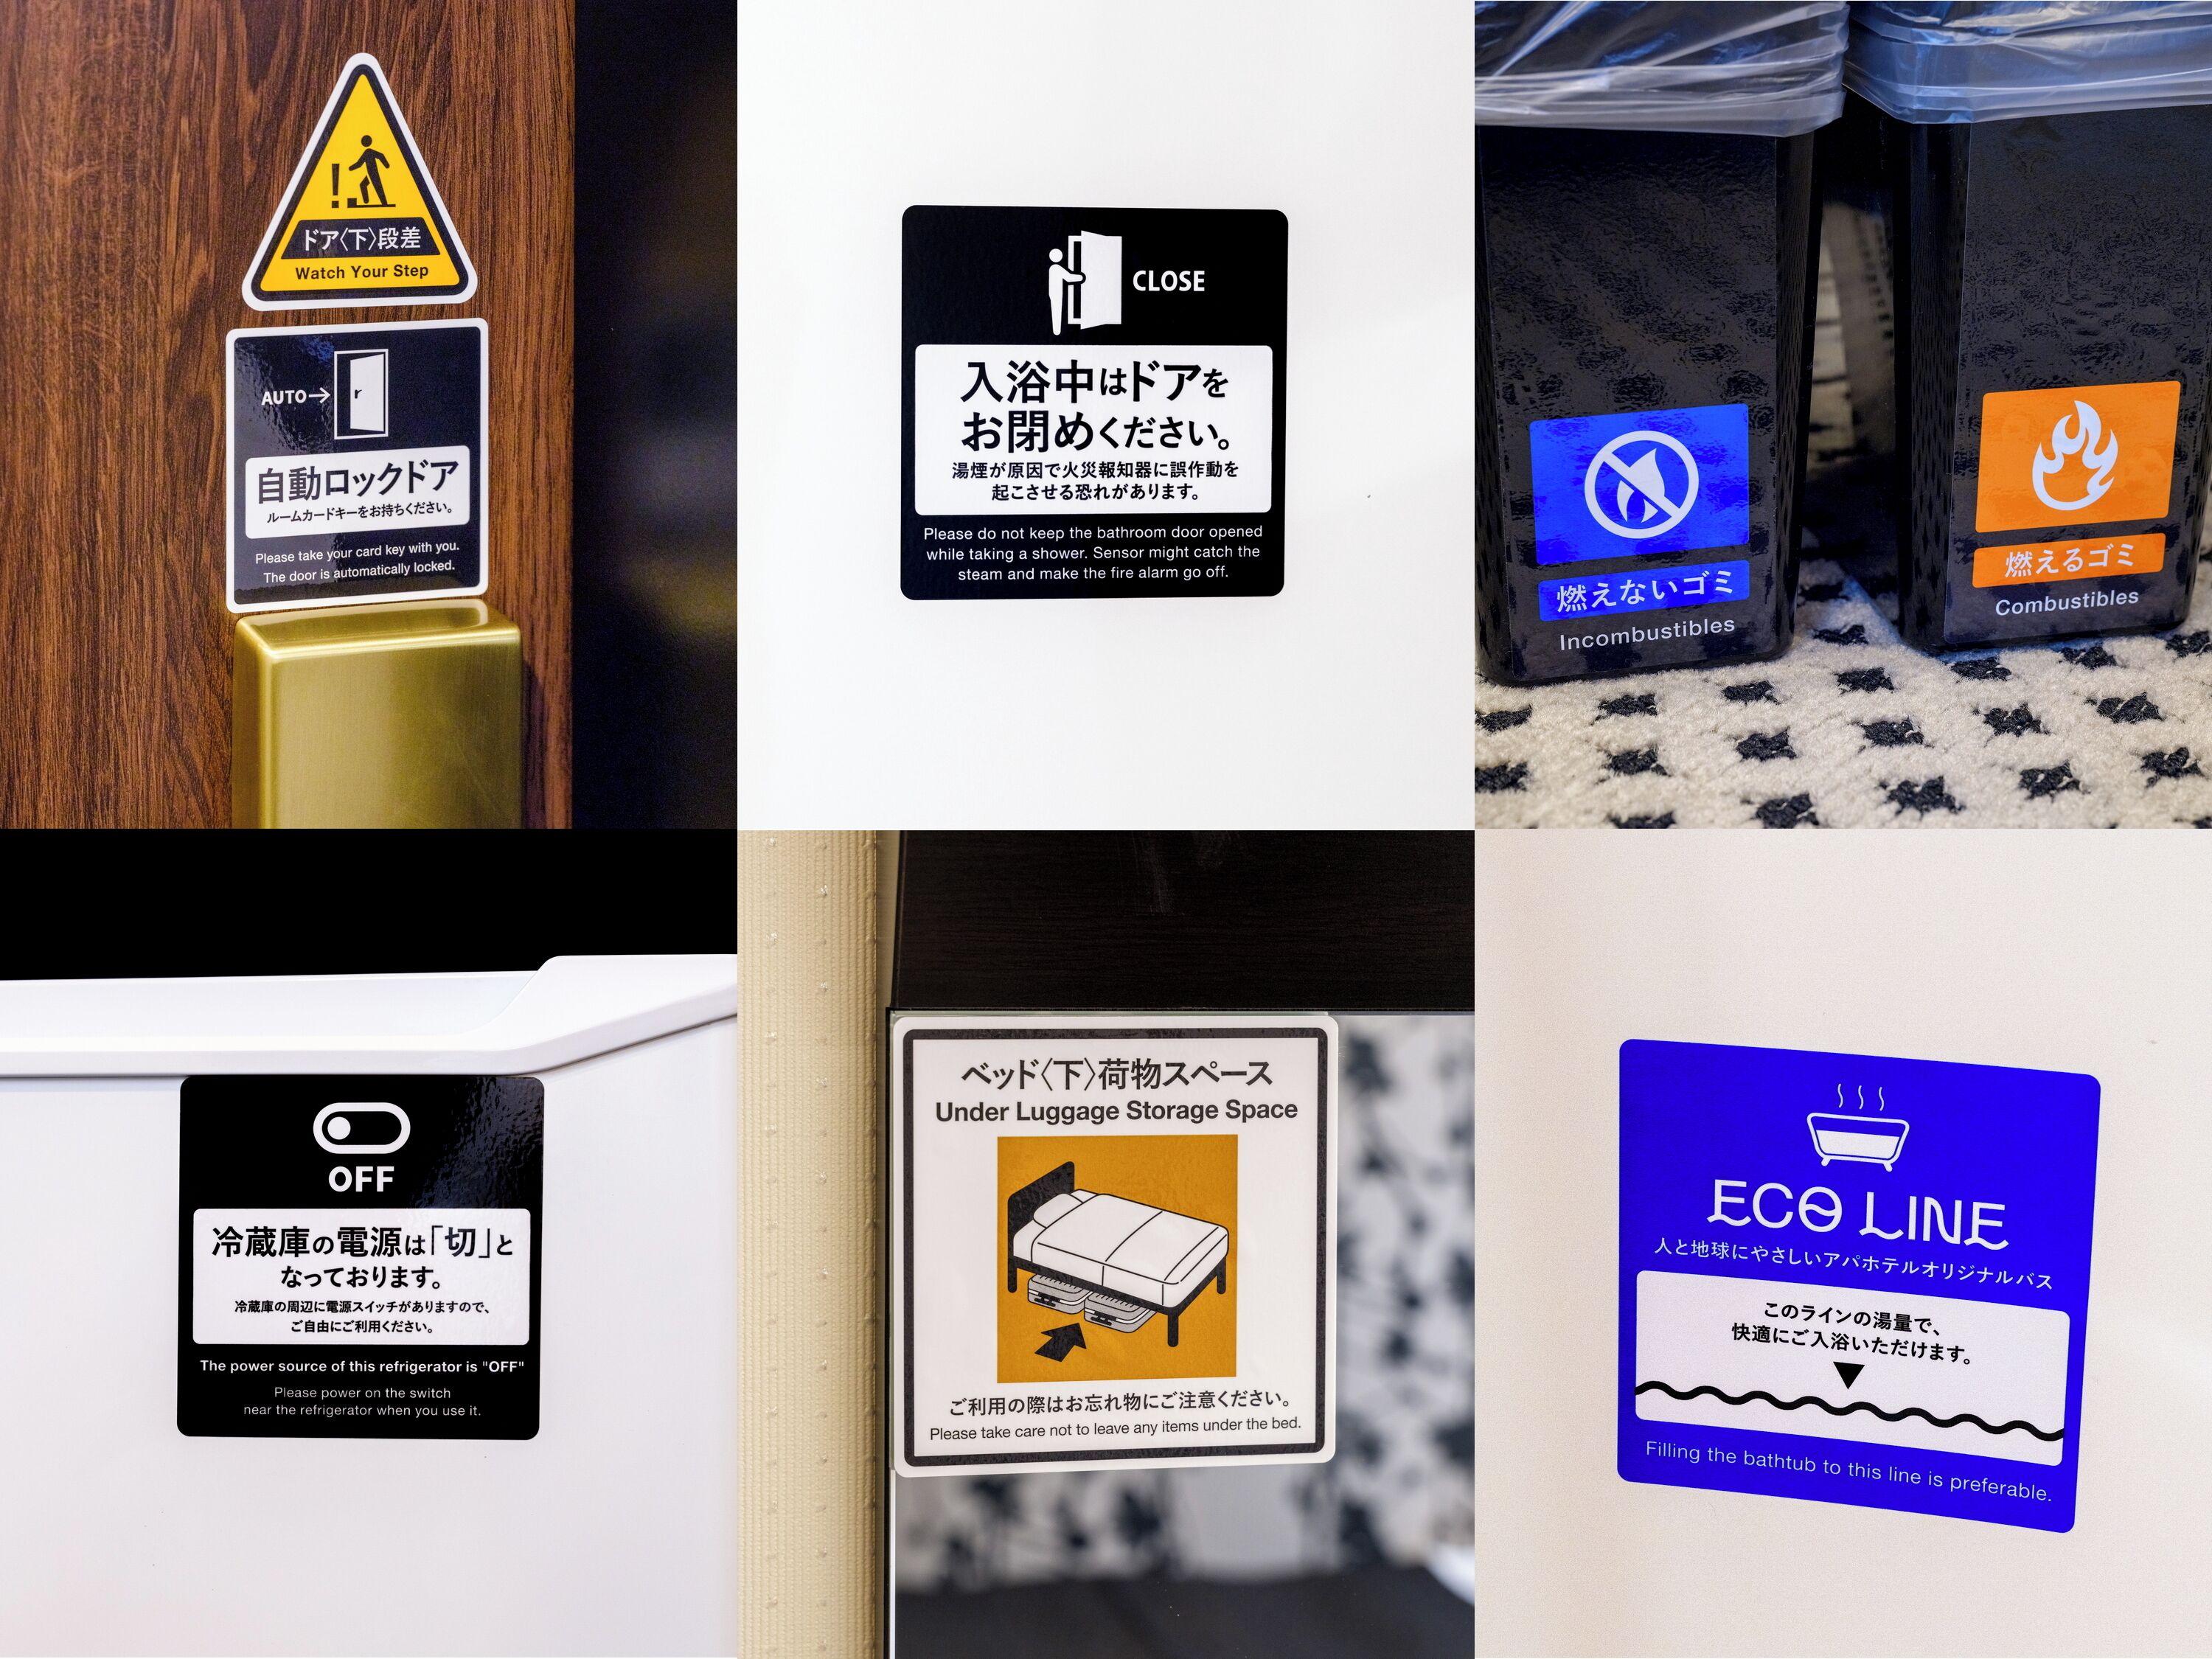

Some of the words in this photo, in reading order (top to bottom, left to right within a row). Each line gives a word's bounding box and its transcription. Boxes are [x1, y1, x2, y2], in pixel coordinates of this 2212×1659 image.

[296, 266, 344, 279] Watch
[351, 265, 388, 278] Your
[394, 265, 428, 279] Step
[1133, 271, 1204, 291] CLOSE
[961, 360, 1228, 403] 入浴中はドアを
[261, 390, 306, 406] AUTO
[961, 411, 1229, 453] お閉めください。
[953, 461, 1238, 479] 湯煙が原因で火災報知器に誤作動を
[259, 459, 459, 505] 自動ロックドア
[992, 484, 1197, 501] 起こさせる恐れがあります。
[268, 501, 451, 523] ルームカードキーをお持ちください。
[925, 528, 973, 540] Please
[978, 528, 995, 539] do
[1002, 528, 1024, 539] not
[1030, 527, 1064, 541] keep
[1070, 527, 1092, 538] the
[1098, 526, 1166, 538] bathroom
[1172, 526, 1204, 538] door
[1209, 526, 1262, 540] opened
[256, 553, 294, 564] Please
[298, 550, 323, 560] take
[327, 550, 352, 562] your
[356, 545, 381, 557] card
[386, 545, 405, 557] key
[408, 542, 432, 553] with
[436, 543, 459, 554] you.
[927, 549, 964, 560] while
[969, 548, 1013, 563] taking
[1019, 551, 1027, 559] a
[1032, 547, 1087, 559] shower.
[1093, 546, 1144, 558] Sensor
[1150, 546, 1189, 560] might
[1194, 546, 1232, 557] catch
[1238, 546, 1259, 557] the
[2005, 543, 2135, 578] 燃えるゴミ
[263, 573, 285, 583] The
[290, 571, 316, 581] door
[321, 569, 330, 579] is
[333, 563, 410, 578] automatically
[414, 560, 454, 572] locked.
[959, 569, 1002, 580] steam
[1008, 568, 1034, 580] and
[1040, 568, 1078, 579] make
[1084, 567, 1105, 578] the
[1111, 567, 1133, 578] fire
[1139, 567, 1178, 578] alarm
[1183, 568, 1200, 580] go
[1206, 566, 1228, 577] off.
[1557, 571, 1733, 612] 燃えないゴミ
[1996, 590, 2138, 616] Combustibles
[1559, 616, 1736, 652] Incombustibles
[936, 1102, 1009, 1121] Under
[1018, 1102, 1119, 1125] Luggage
[1127, 1100, 1218, 1124] Storage
[1225, 1099, 1298, 1123] Space
[329, 1166, 394, 1192] OFF
[1707, 1180, 1842, 1232] ECO
[1859, 1192, 2008, 1250] LINE
[1655, 1239, 2053, 1290] 人と地球にやさしいアパホテルオリジナルバス
[282, 1266, 439, 1289] なっております。
[235, 1300, 489, 1313] 冷蔵庫の周辺に電源スイッチがありますので、
[292, 1320, 432, 1333] ご自由にご利用ください。
[1764, 1302, 1942, 1335] このラインの湯量で、
[1731, 1323, 1973, 1366] 快適にご入浴いただけます。
[201, 1360, 226, 1371] The
[231, 1363, 274, 1373] power
[279, 1363, 327, 1371] source
[332, 1361, 345, 1371] of
[349, 1361, 375, 1371] this
[380, 1361, 462, 1374] refrigerator
[467, 1361, 477, 1371] is
[483, 1361, 524, 1372] "OFF"
[275, 1387, 316, 1397] Please
[322, 1390, 361, 1399] power
[386, 1388, 405, 1398] the
[410, 1388, 450, 1398] switch
[950, 1390, 1288, 1416] ご利用の際はお忘れ物にご注意ください。
[276, 1405, 296, 1414] the
[301, 1405, 372, 1417] refrigerator
[377, 1405, 410, 1415] when
[415, 1408, 437, 1418] you
[470, 1406, 480, 1416] it.
[931, 1428, 976, 1440] Please
[981, 1426, 1010, 1438] take
[1015, 1427, 1045, 1437] care
[1051, 1425, 1071, 1436] not
[1076, 1424, 1089, 1435] to
[1095, 1423, 1129, 1434] leave
[1134, 1424, 1158, 1436] any
[1163, 1421, 1198, 1432] items
[1204, 1419, 1242, 1431] under
[1246, 1418, 1267, 1430] the
[1273, 1416, 1301, 1429] bed.
[1647, 1441, 1700, 1463] Filling
[1708, 1447, 1736, 1463] the
[1745, 1450, 1815, 1472] bathtub
[1823, 1460, 1840, 1474] to
[1848, 1460, 1882, 1480] this
[1890, 1467, 1921, 1484] line
[1929, 1471, 1942, 1486] is
[1950, 1473, 2052, 1502] preferable.
